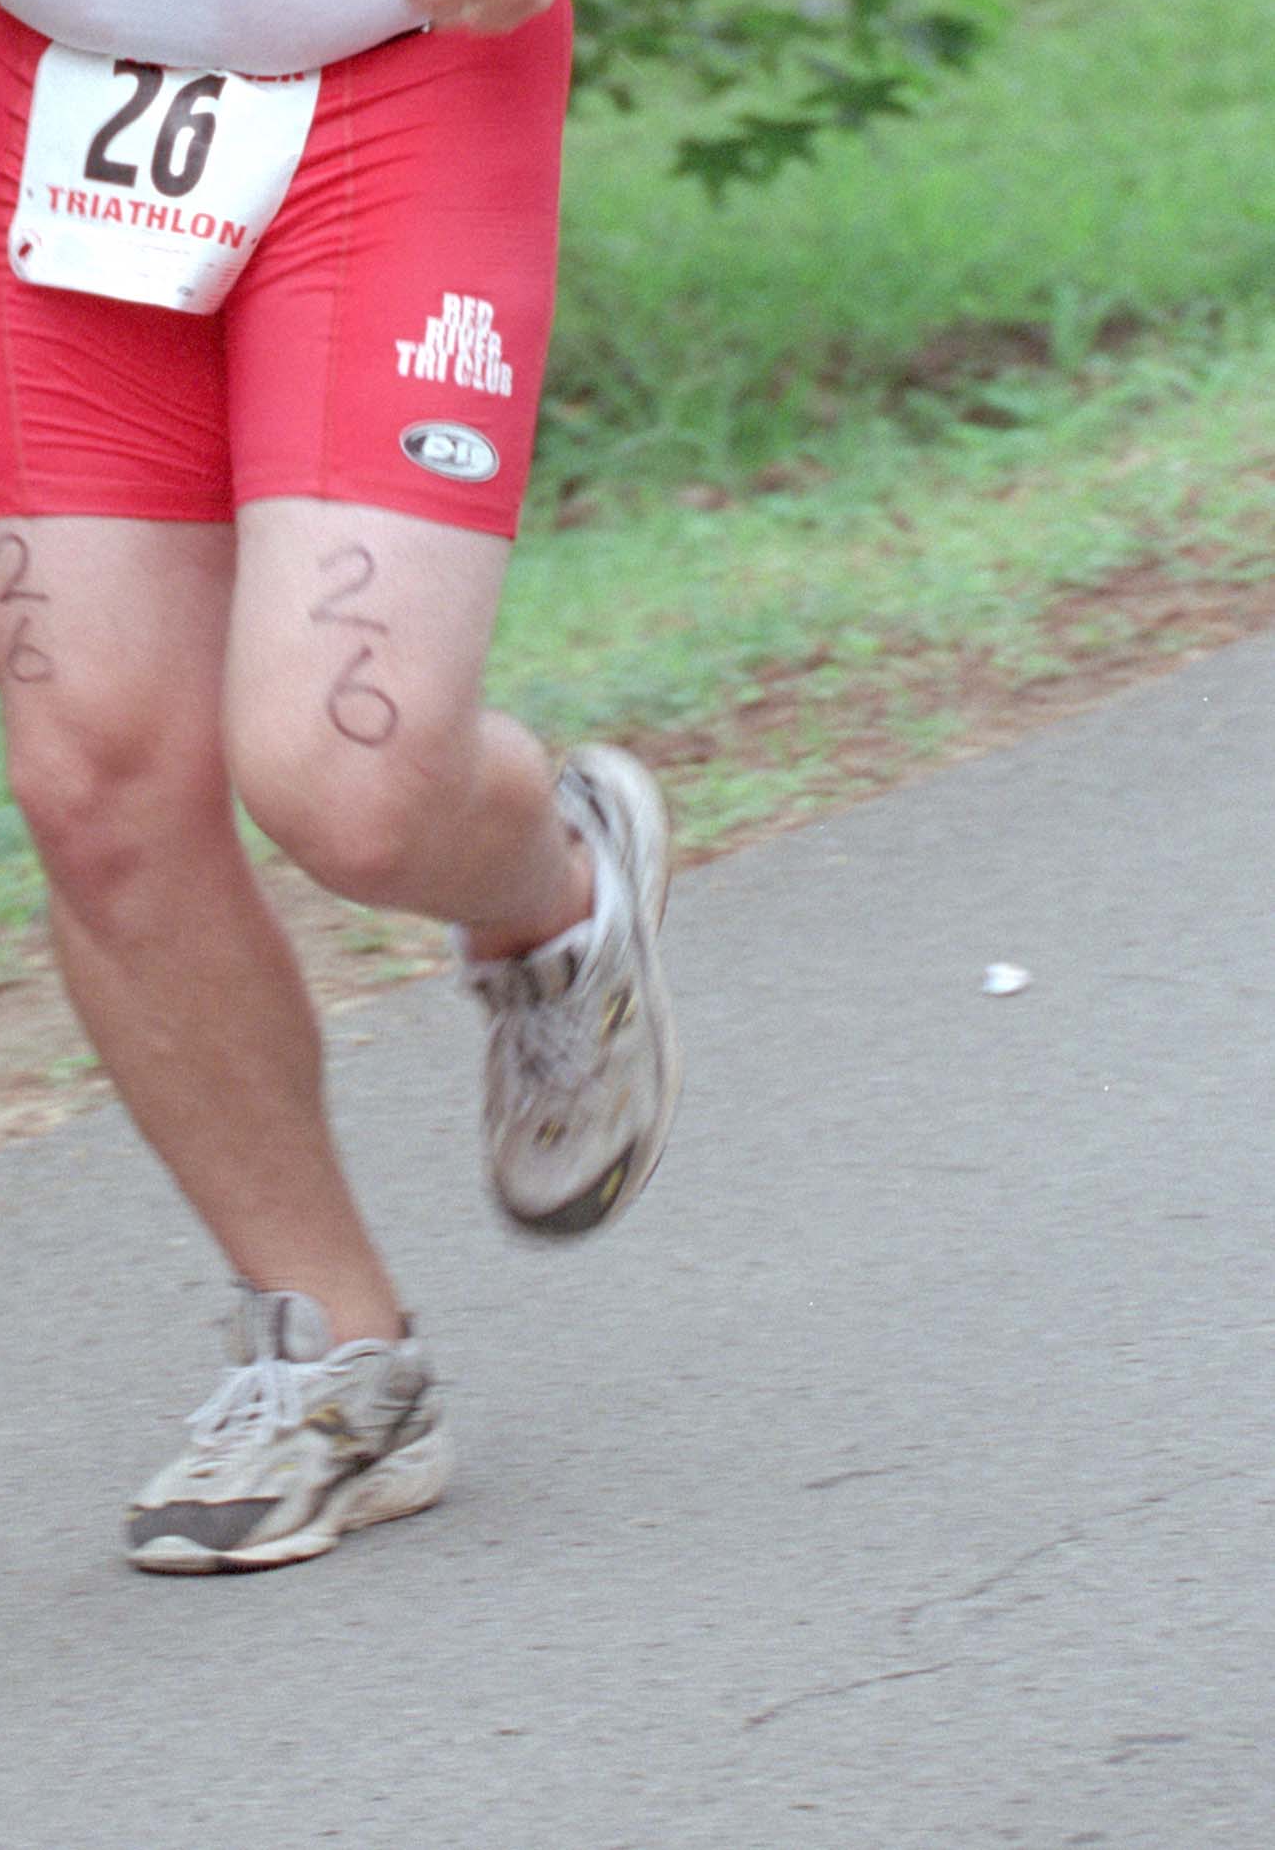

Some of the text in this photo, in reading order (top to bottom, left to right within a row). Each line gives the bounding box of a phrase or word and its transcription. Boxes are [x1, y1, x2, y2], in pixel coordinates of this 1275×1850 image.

[83, 58, 228, 198] 26
[47, 185, 247, 250] TRIATHLON
[425, 316, 502, 357] RIVER
[443, 292, 494, 332] RED
[395, 338, 513, 397] TRI CLUB
